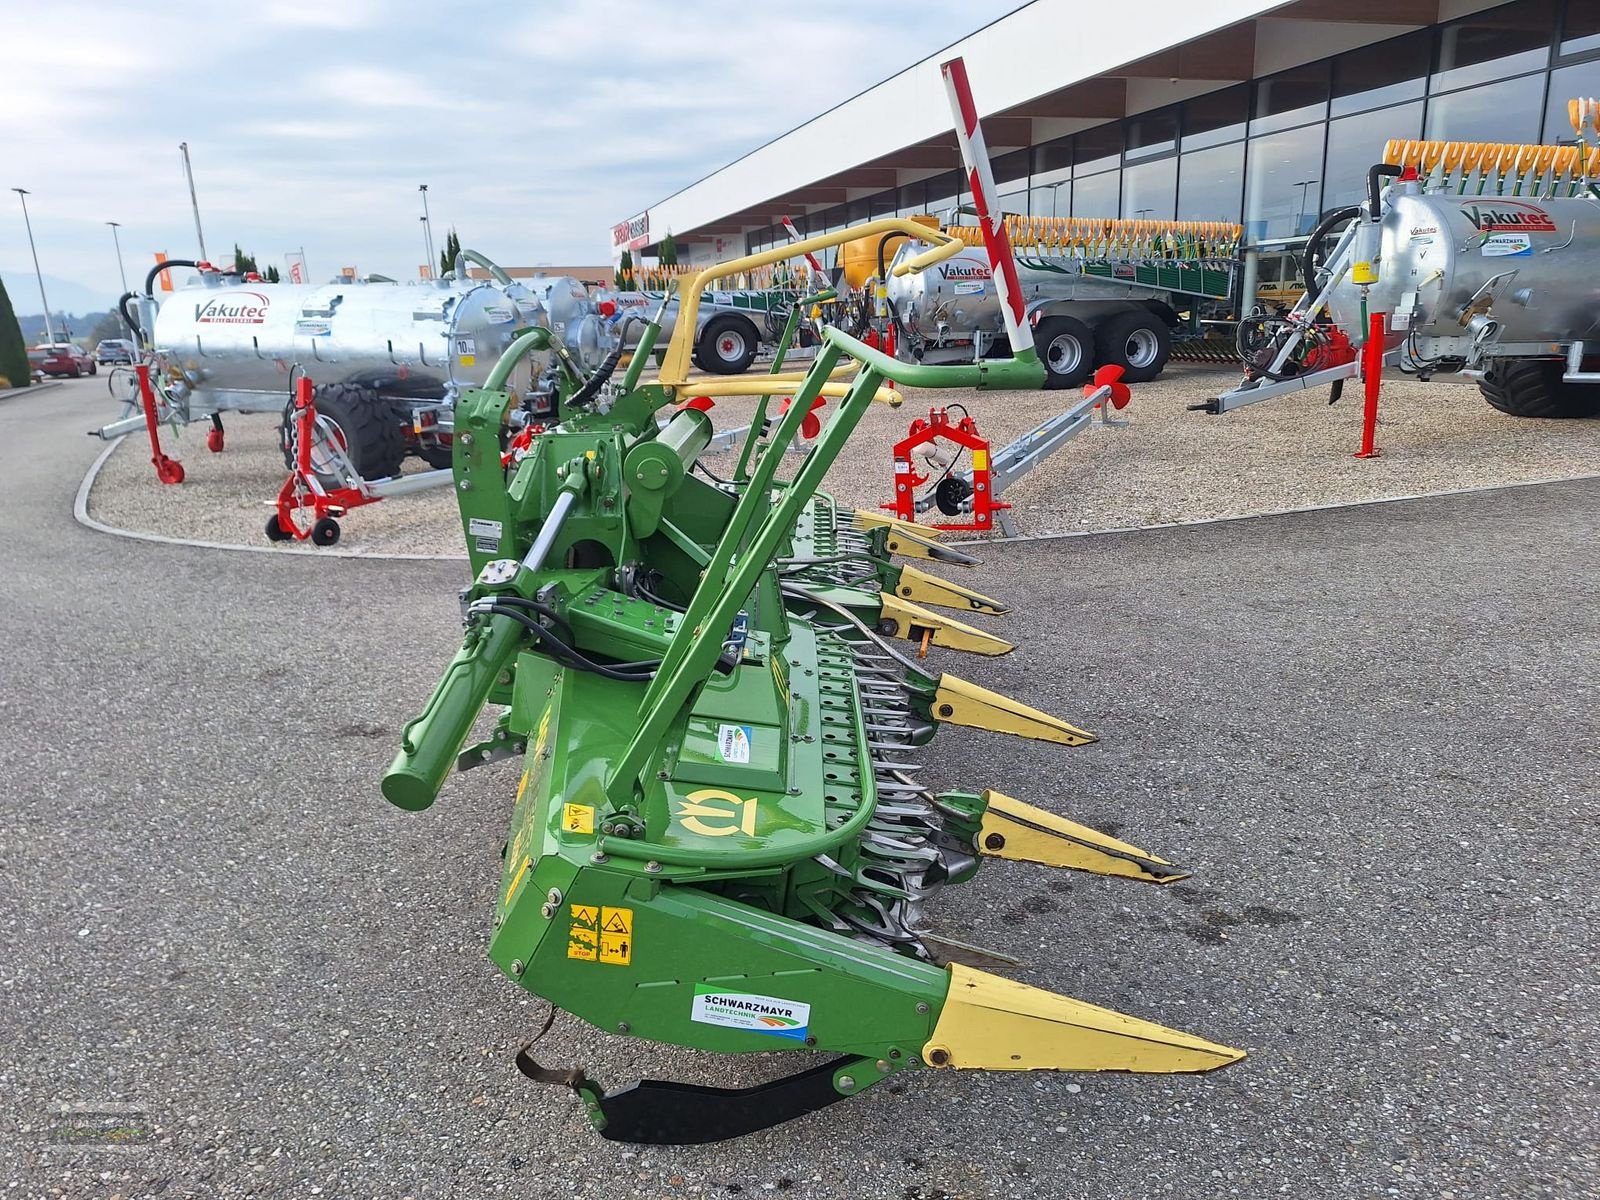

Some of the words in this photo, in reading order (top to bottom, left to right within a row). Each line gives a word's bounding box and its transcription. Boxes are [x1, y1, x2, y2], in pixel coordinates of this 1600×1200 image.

[1460, 205, 1553, 230] Vakutec
[938, 264, 991, 280] Vakutec
[195, 299, 268, 322] Vakutec
[458, 341, 467, 353] 10
[704, 995, 793, 1017] SCHWARZMAYR
[705, 1005, 756, 1019] LANDTECHNIK
